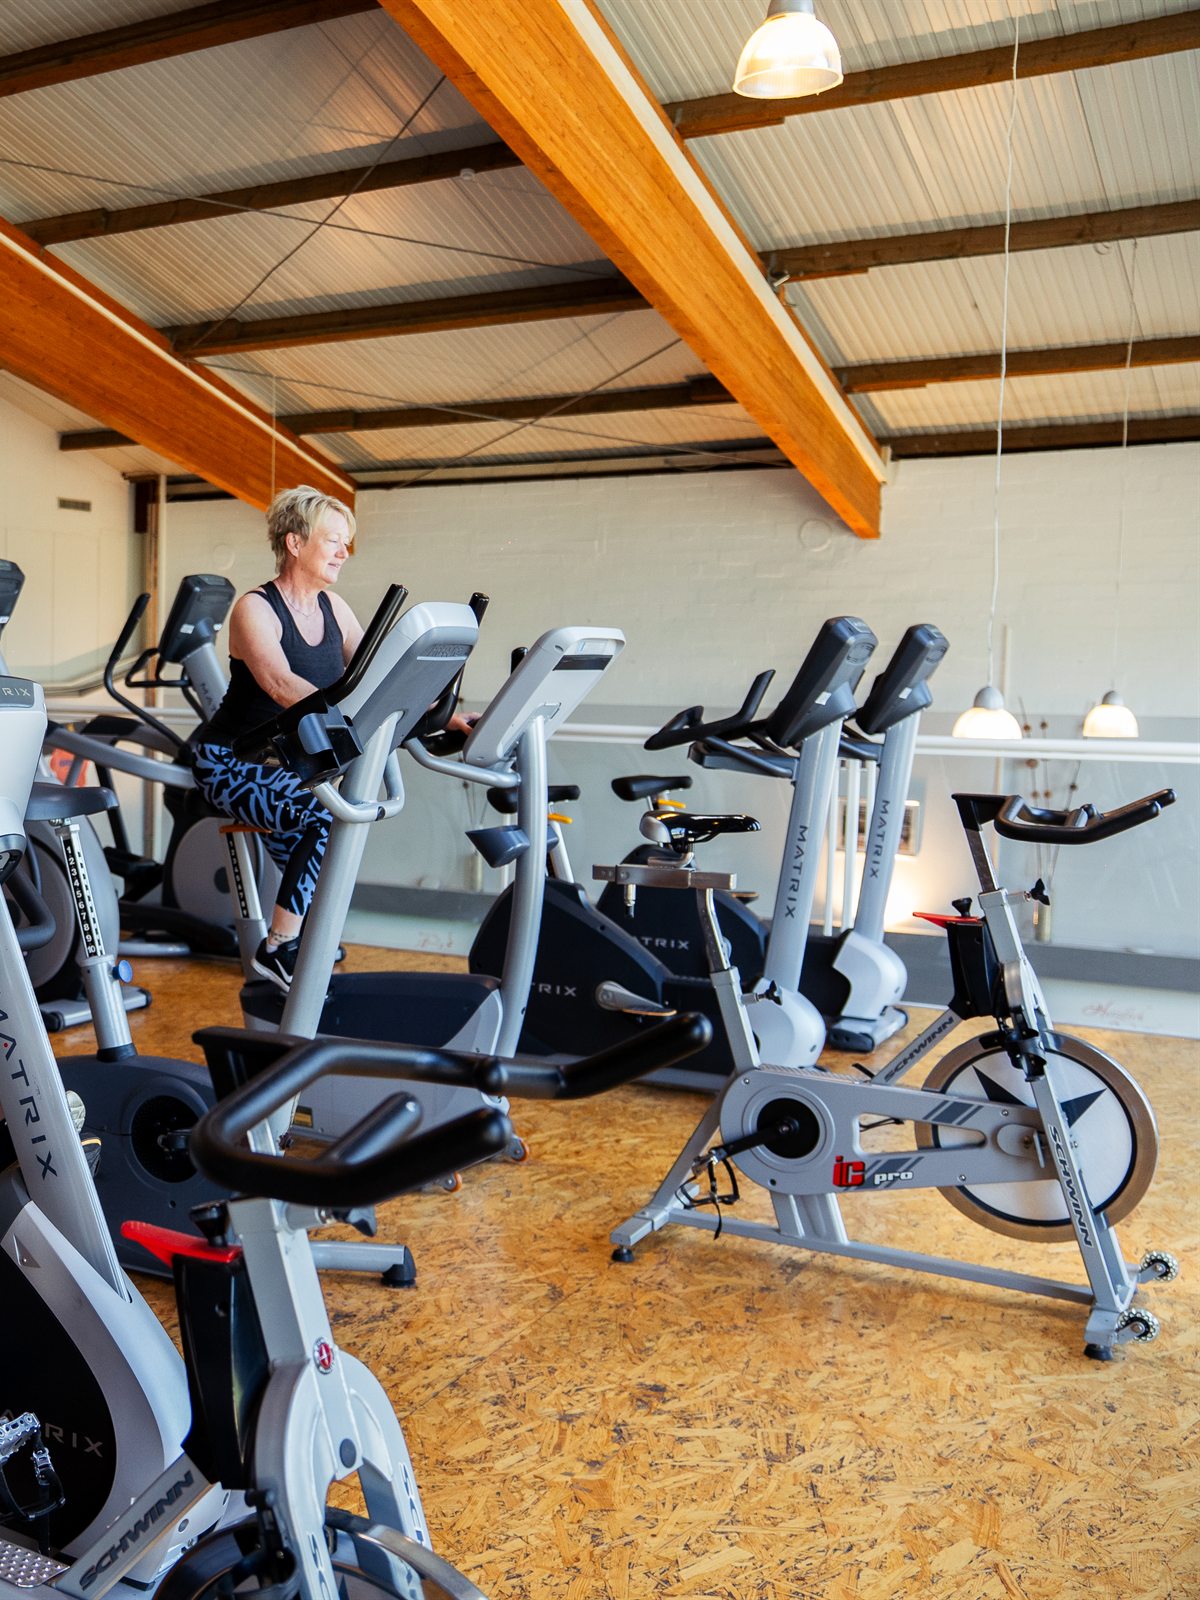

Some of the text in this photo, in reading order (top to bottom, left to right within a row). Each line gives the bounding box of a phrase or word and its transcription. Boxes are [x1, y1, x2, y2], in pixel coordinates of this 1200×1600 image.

[785, 825, 808, 919] MATRIX
[870, 800, 890, 878] MATRIX
[641, 936, 690, 951] TRIX
[535, 982, 577, 998] RIX
[884, 1016, 954, 1083] SCHWINN
[874, 1171, 913, 1185] pro
[1048, 1124, 1093, 1247] SCHWINN
[79, 1470, 195, 1591] SCHWINN
